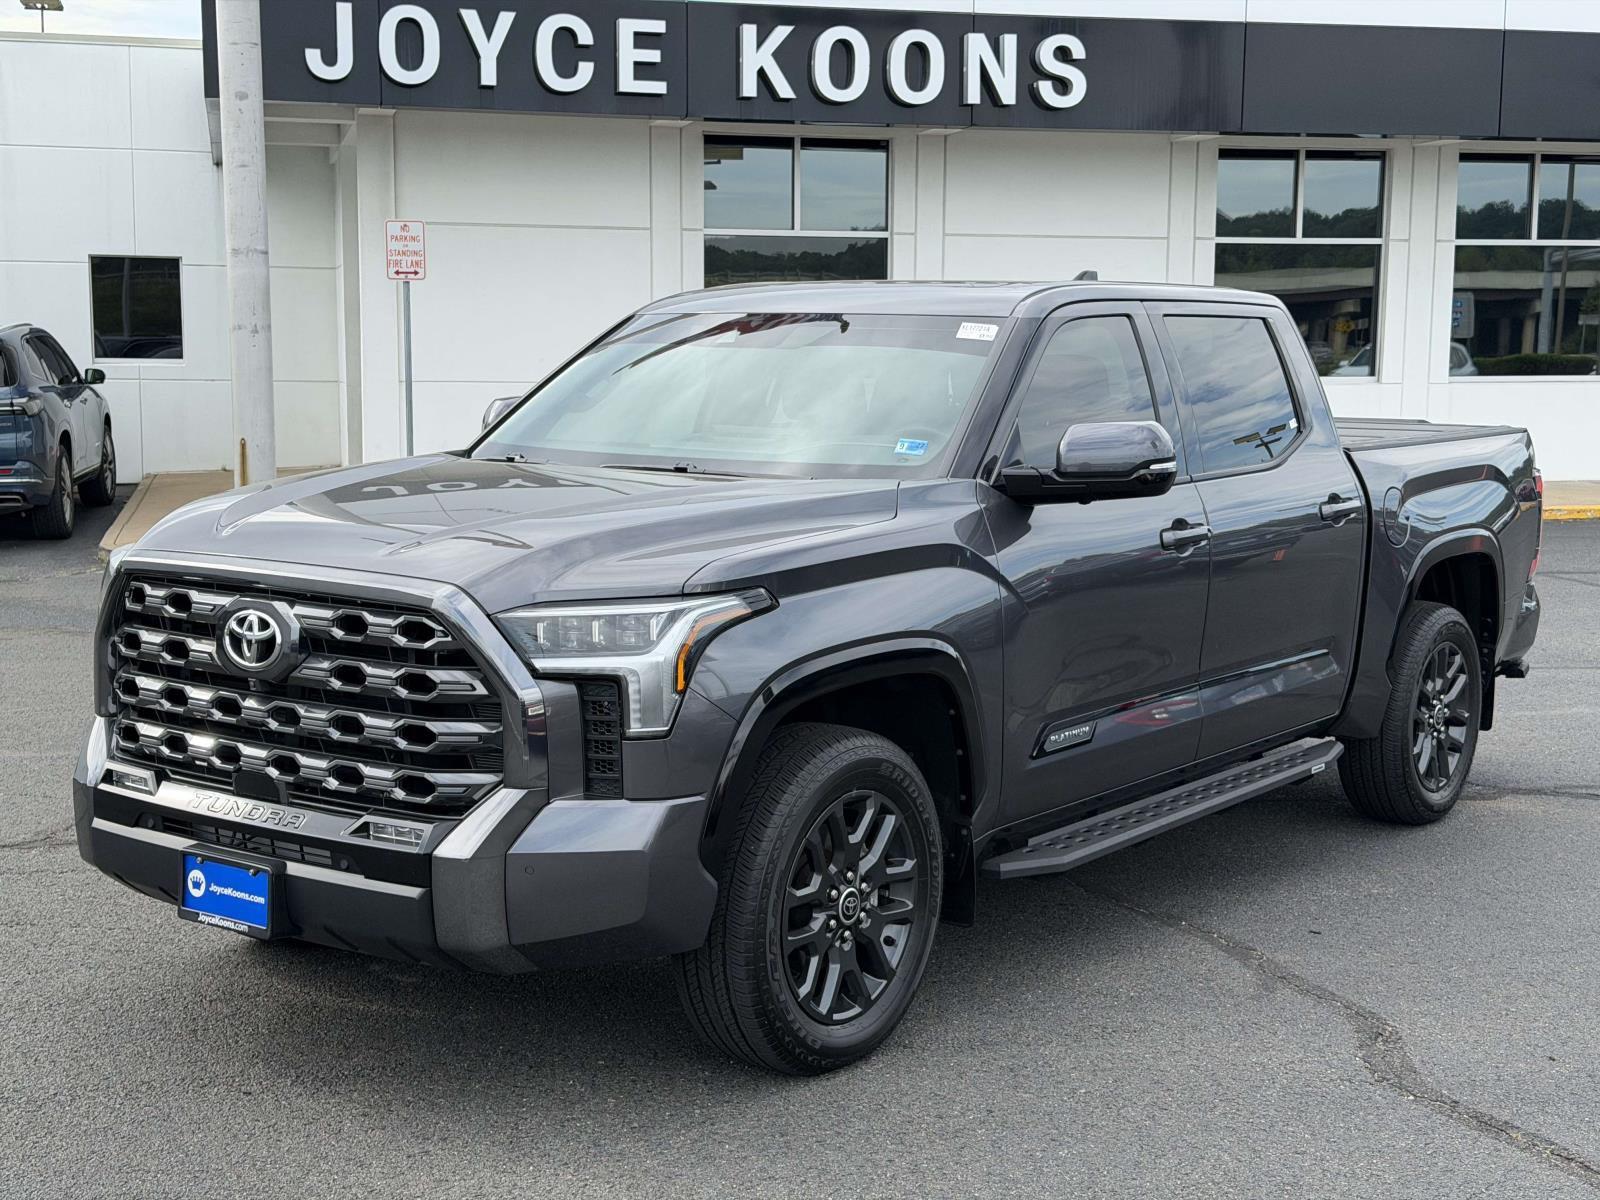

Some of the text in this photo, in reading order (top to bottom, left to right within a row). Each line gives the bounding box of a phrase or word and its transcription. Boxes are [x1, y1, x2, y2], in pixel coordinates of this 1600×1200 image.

[304, 1, 1087, 109] JOYCE KOONS
[400, 224, 410, 233] NO
[390, 235, 421, 243] PARKING
[389, 249, 423, 258] STANDING
[388, 259, 424, 269] FIRE LANE
[1050, 725, 1089, 742] PLATINUM
[192, 792, 306, 830] TUNDRA
[208, 882, 265, 905] JoyceKoons.com
[198, 912, 249, 934] JoyceKoons.com
